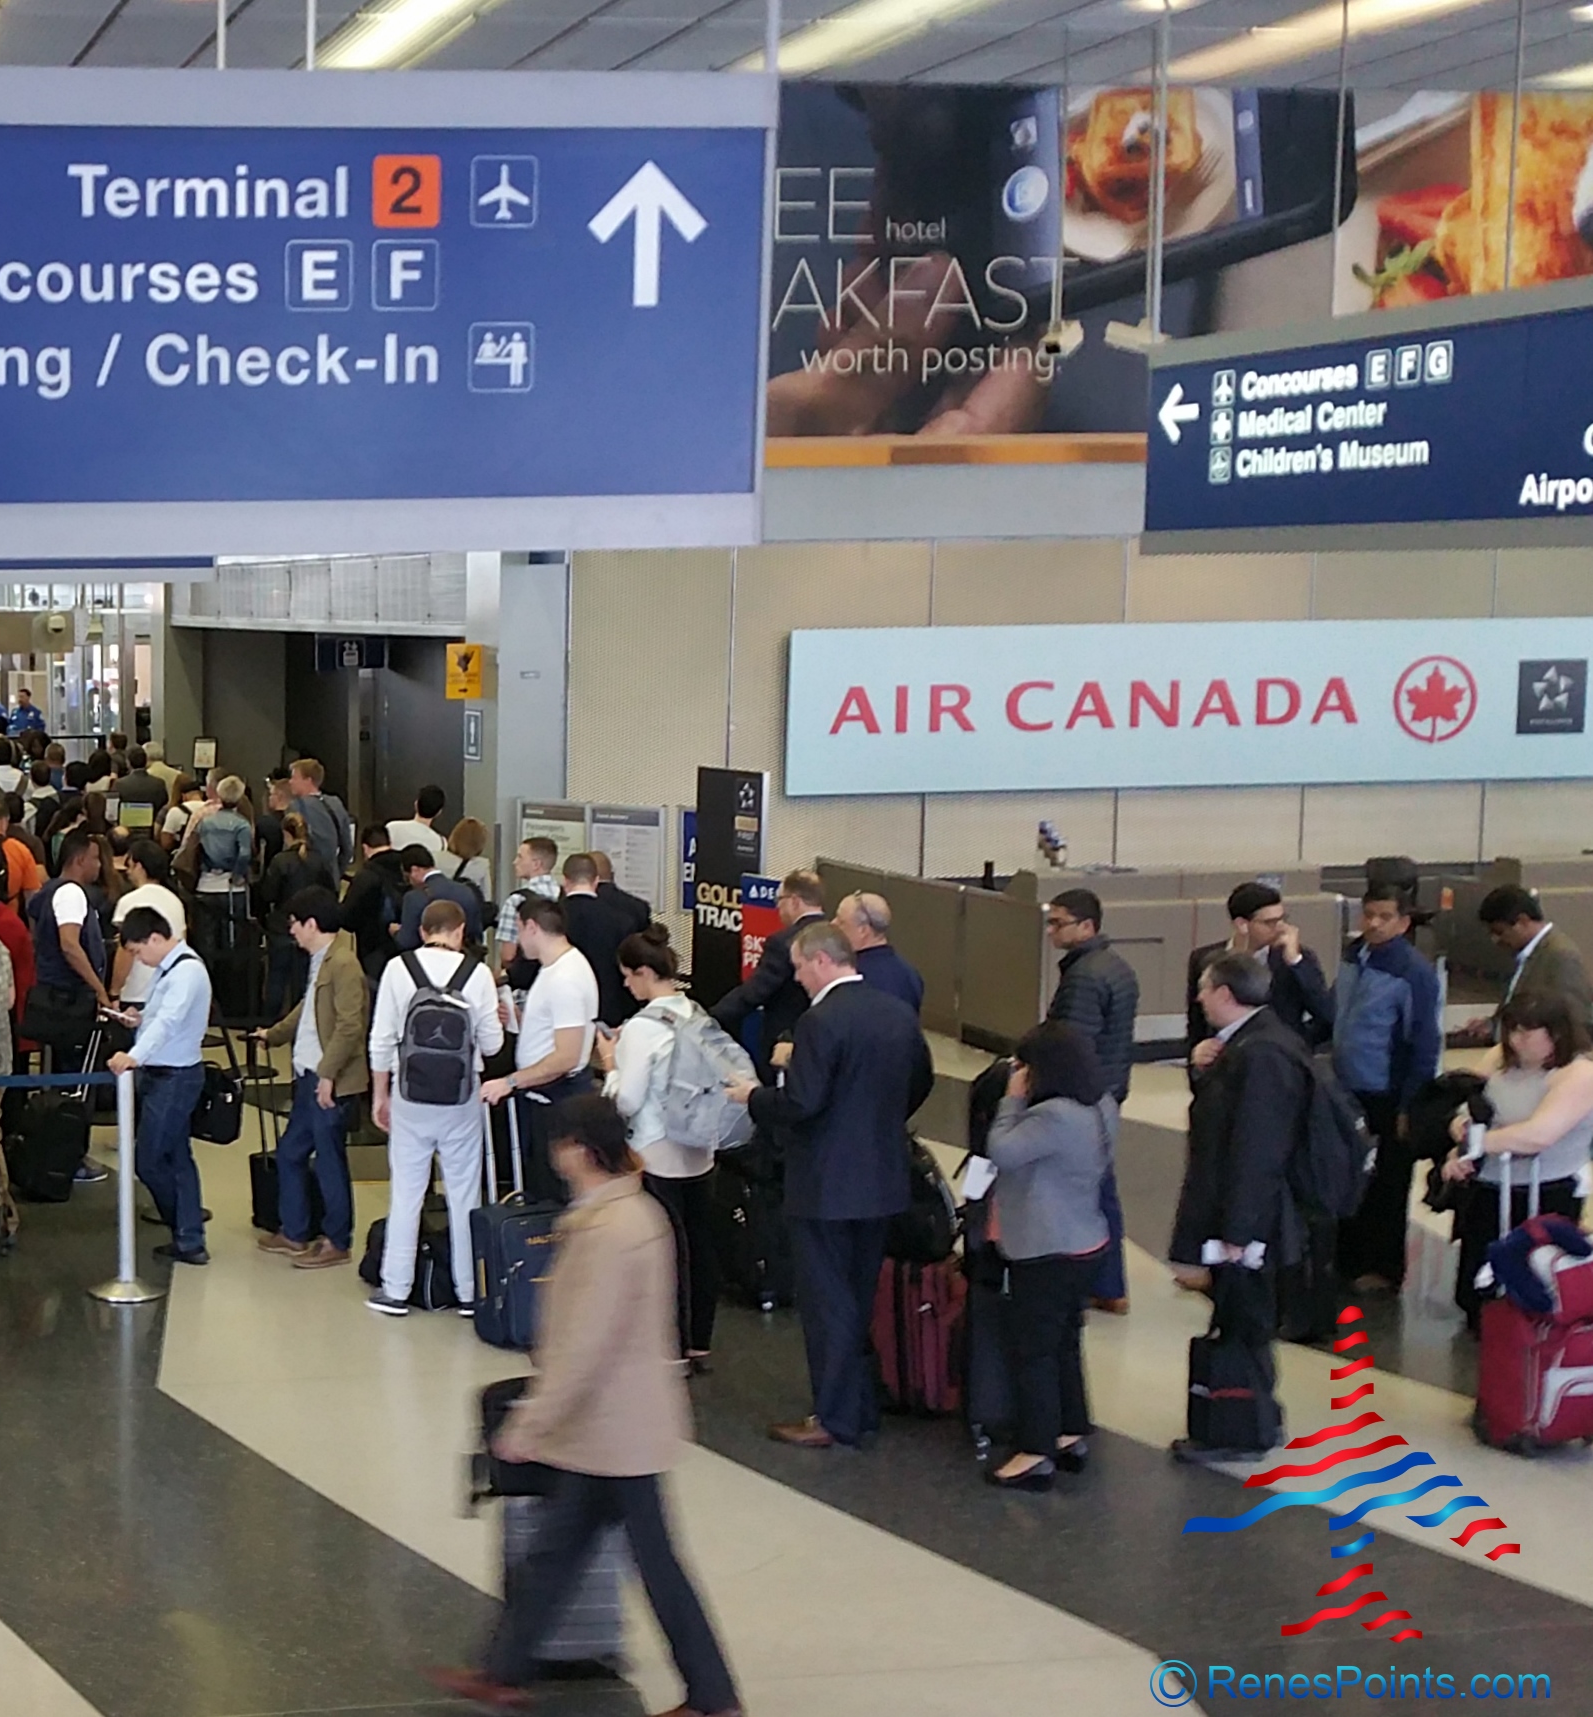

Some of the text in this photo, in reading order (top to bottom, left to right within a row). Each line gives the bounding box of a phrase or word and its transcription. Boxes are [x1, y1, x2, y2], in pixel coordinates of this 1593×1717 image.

[67, 163, 423, 219] Terminal 2
[885, 215, 947, 242] hotel
[300, 251, 339, 300] E
[390, 251, 423, 299] F
[97, 333, 122, 388] /
[145, 331, 440, 388] Check-In
[800, 337, 909, 375] worth
[1241, 346, 1449, 400] Concourses E F G
[1238, 399, 1388, 438] Medical Center
[1236, 440, 1430, 478] Children's Museum
[827, 676, 1359, 737] AIR CANADA
[695, 903, 744, 932] TRAC
